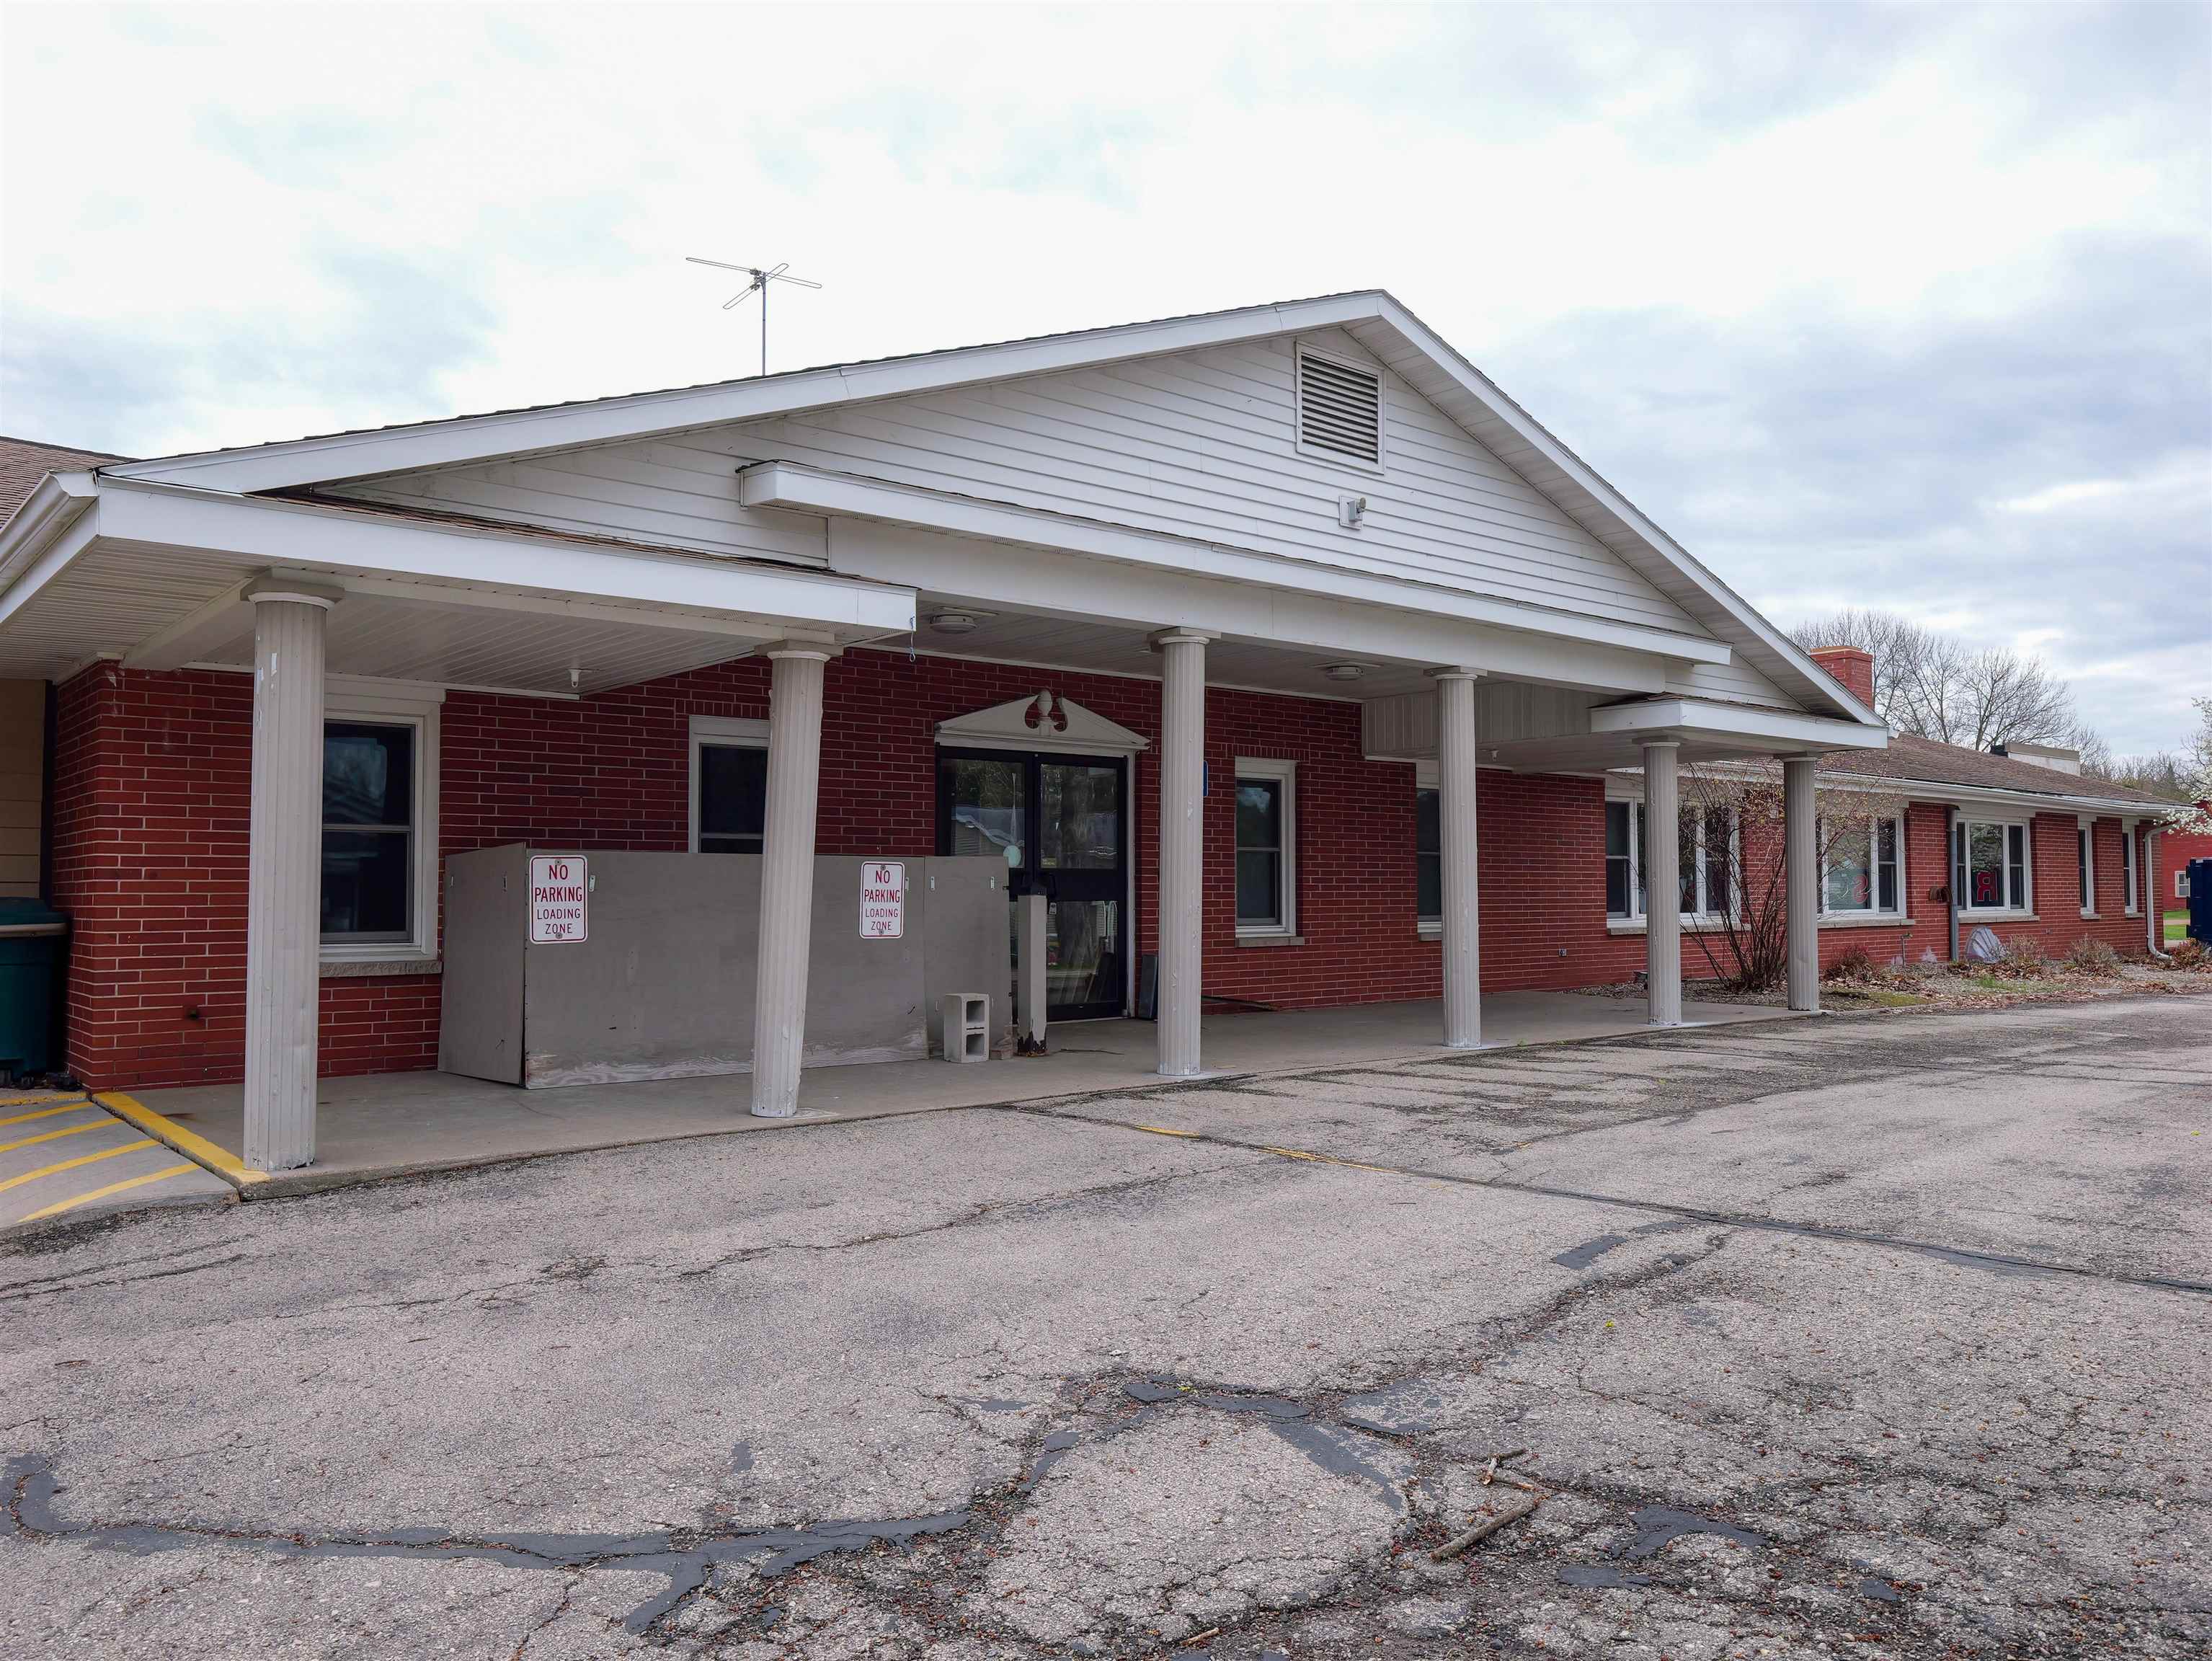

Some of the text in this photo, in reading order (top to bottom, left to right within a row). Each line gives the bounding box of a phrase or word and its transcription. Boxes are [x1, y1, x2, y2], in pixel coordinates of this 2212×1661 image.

[548, 864, 569, 880] NO
[875, 869, 890, 884] NO
[534, 886, 582, 903] PARKING
[864, 889, 900, 903] PARKING
[537, 908, 580, 920] LOADING
[865, 908, 898, 918] LOADING
[545, 923, 572, 934] ZONE
[871, 921, 892, 931] ZONE
